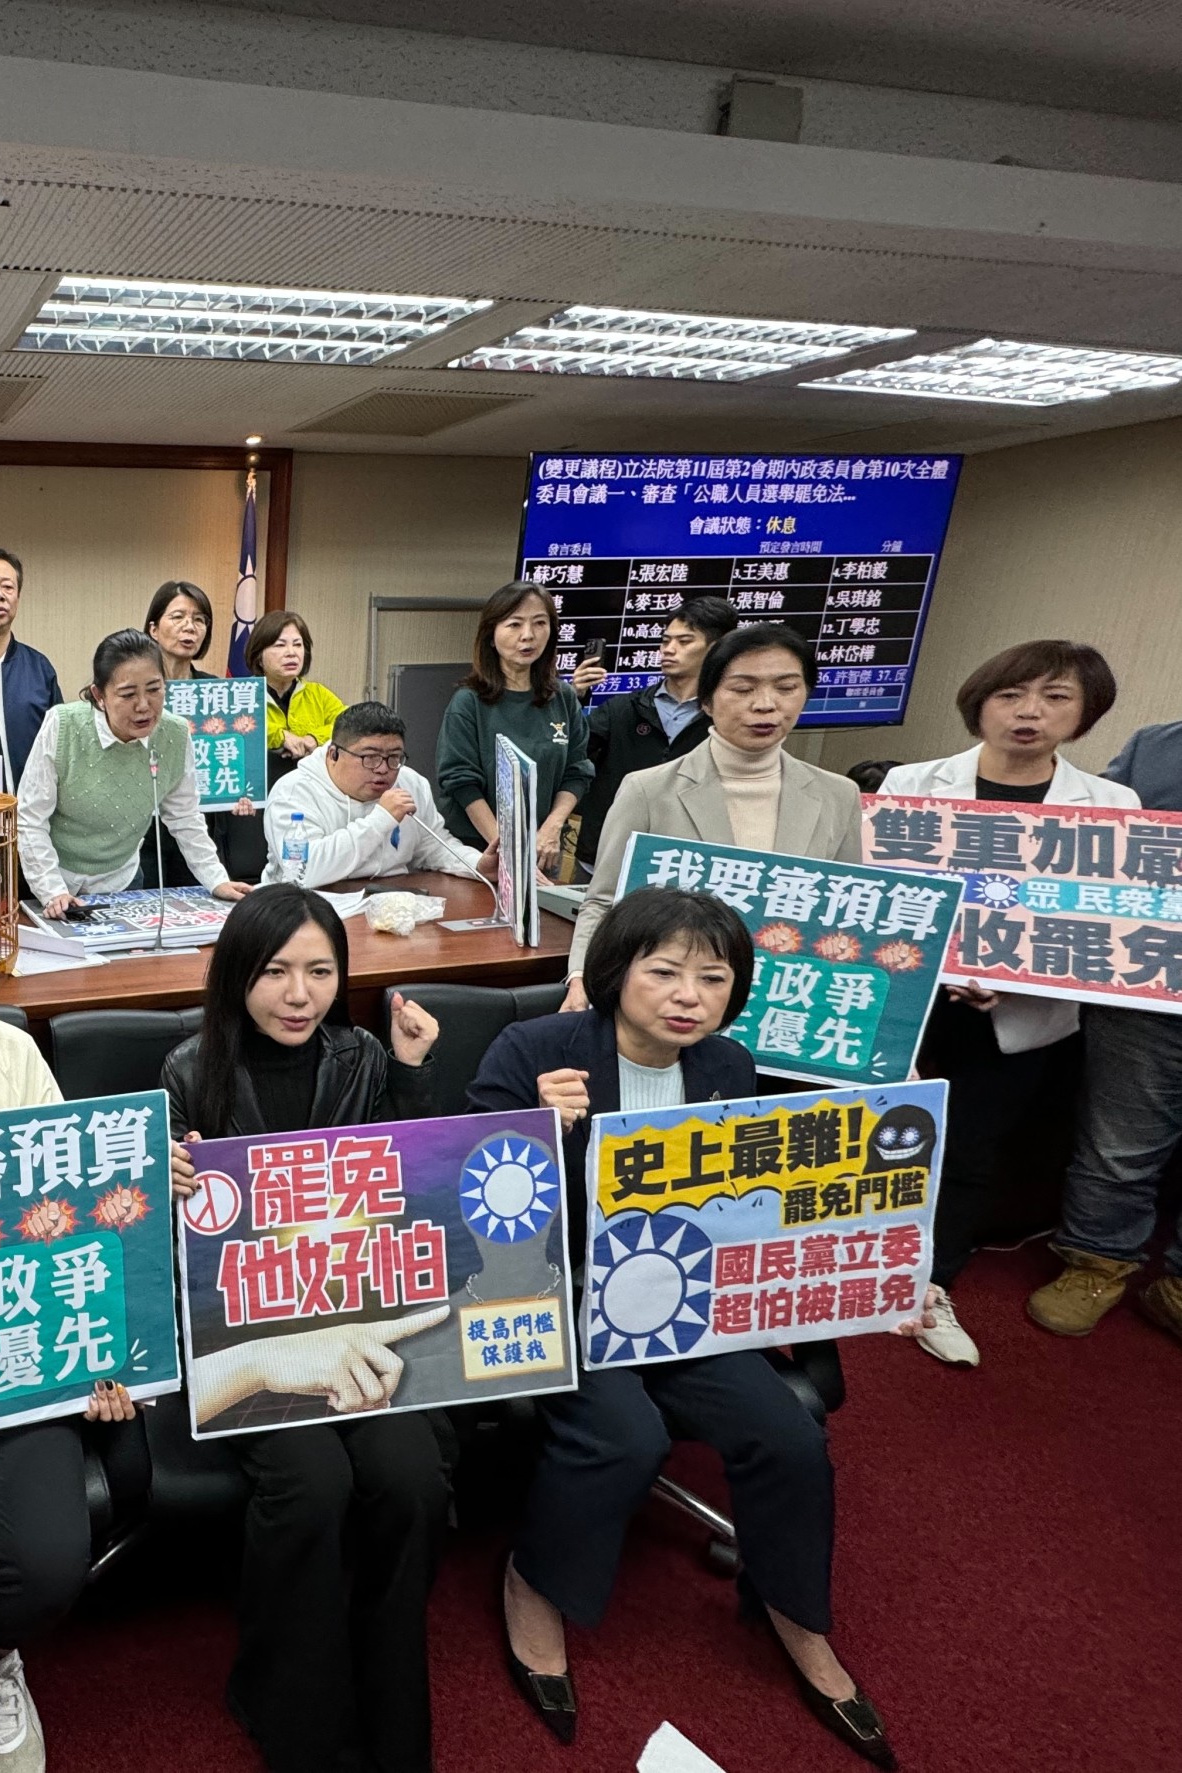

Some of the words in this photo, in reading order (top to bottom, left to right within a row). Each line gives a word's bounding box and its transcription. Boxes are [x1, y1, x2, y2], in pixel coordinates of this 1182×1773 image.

[548, 543, 592, 556] 發言委員
[759, 541, 823, 554] 預定發言時間
[630, 564, 689, 583] 2.張宏陸
[733, 562, 790, 581] 3.王美惠
[557, 623, 576, 643] 瑩
[622, 622, 667, 640] 10.高金
[619, 651, 662, 669] 14.黃建
[167, 681, 259, 716] 審預算
[192, 737, 239, 767] 政爭
[194, 767, 240, 796] 優先
[646, 849, 948, 941] 我要審預算
[956, 908, 1182, 992] 收罷免
[610, 1106, 866, 1202] 史上最難!
[247, 1135, 406, 1230] 罷免
[783, 1172, 926, 1225] 罷免門檻
[714, 1224, 923, 1290] 國民黨立委
[218, 1219, 449, 1327] 他好怕
[711, 1273, 918, 1336] 超怕被罷免
[467, 1311, 557, 1342] 提高門檻
[480, 1338, 547, 1368] 保護我
